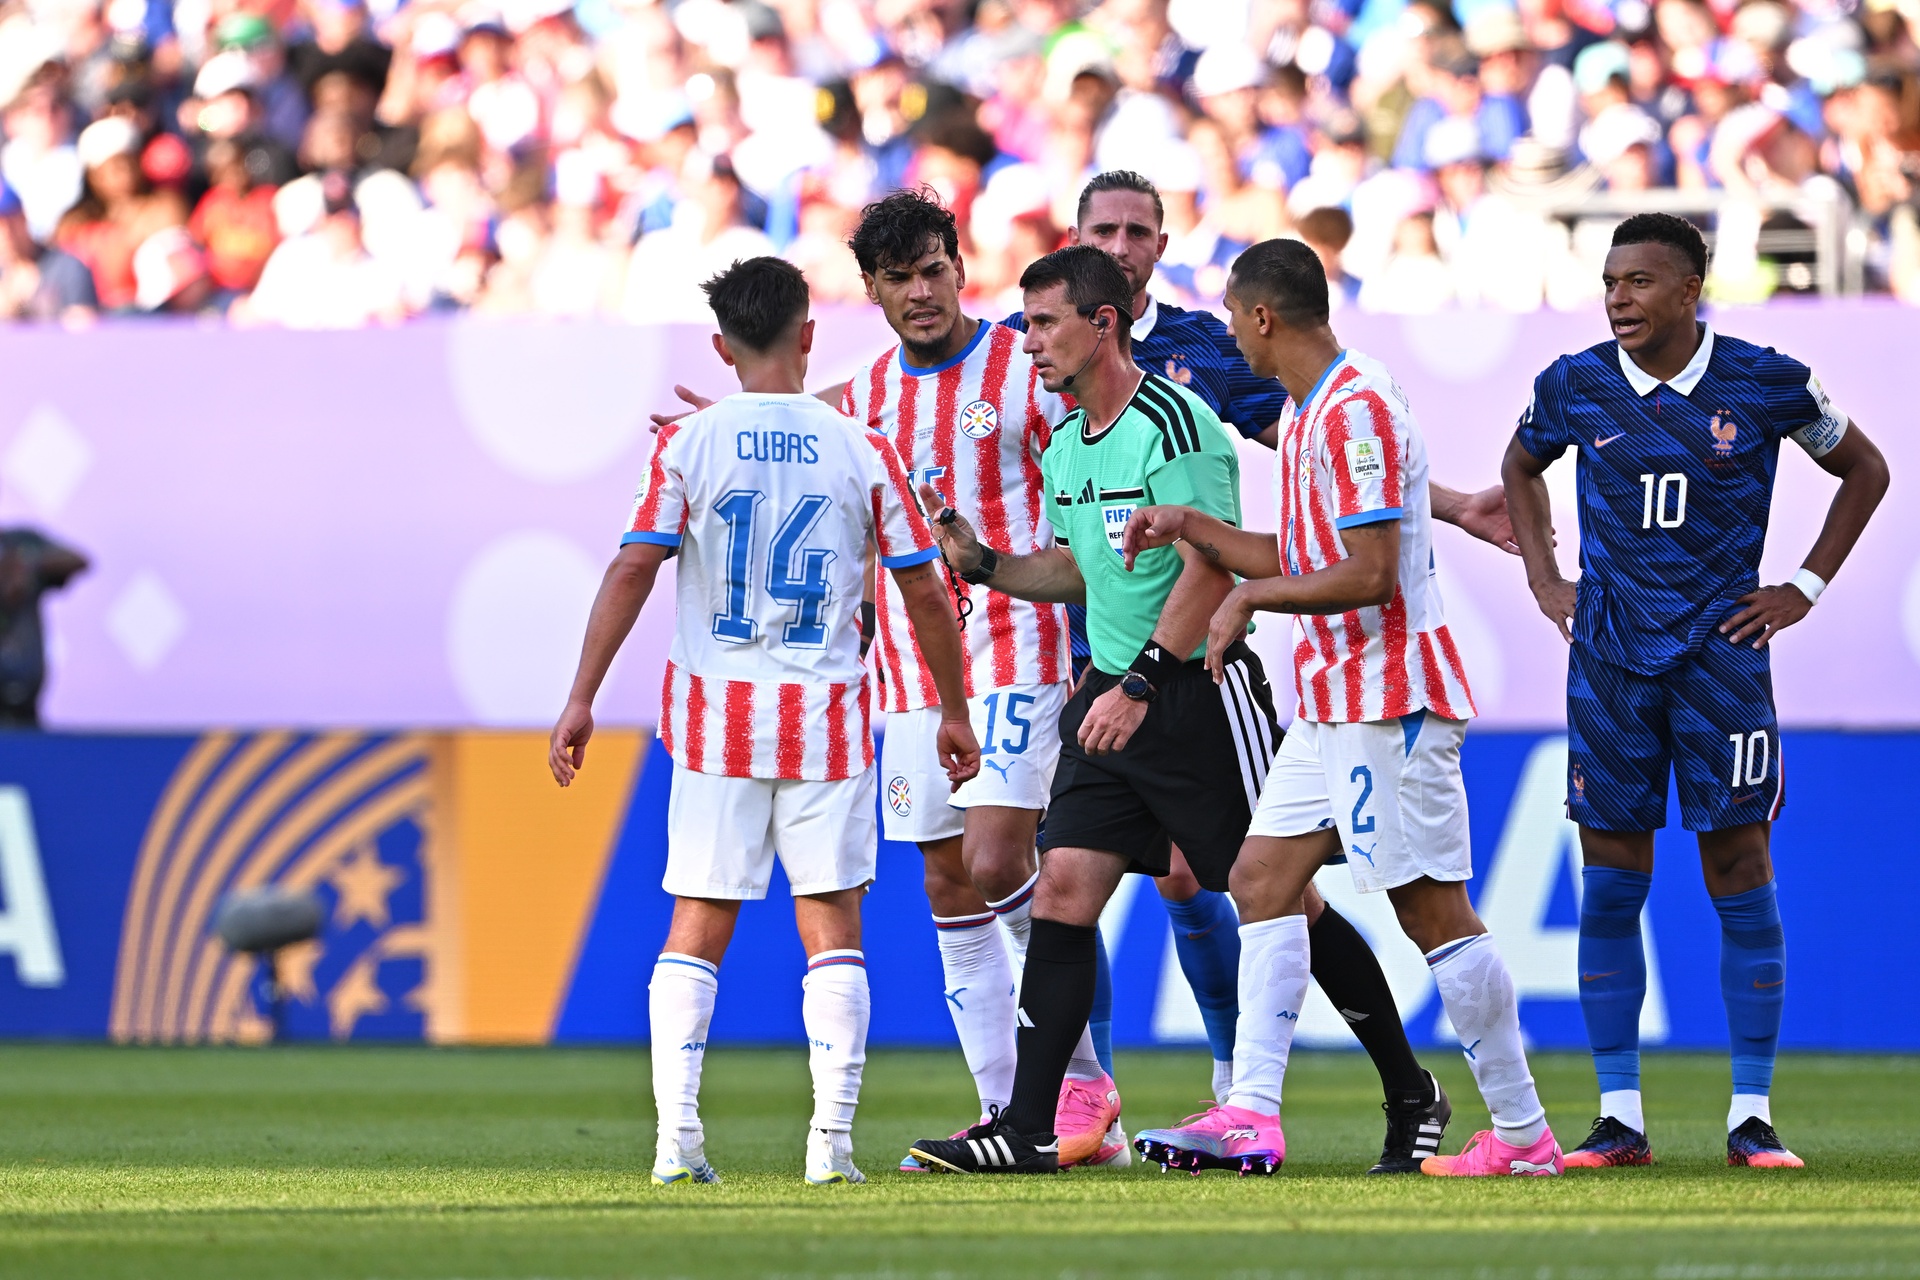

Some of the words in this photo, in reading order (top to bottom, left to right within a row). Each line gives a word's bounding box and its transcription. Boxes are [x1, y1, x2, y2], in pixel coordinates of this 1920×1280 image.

[736, 431, 819, 464] CUBAS
[1806, 413, 1833, 443] UNITES
[1825, 434, 1840, 449] FIFA
[1355, 464, 1380, 473] EDUCATION
[1640, 473, 1687, 529] 10
[712, 489, 838, 650] 14
[980, 693, 1036, 755] 15
[1730, 730, 1769, 787] 10
[1350, 765, 1375, 834] 2
